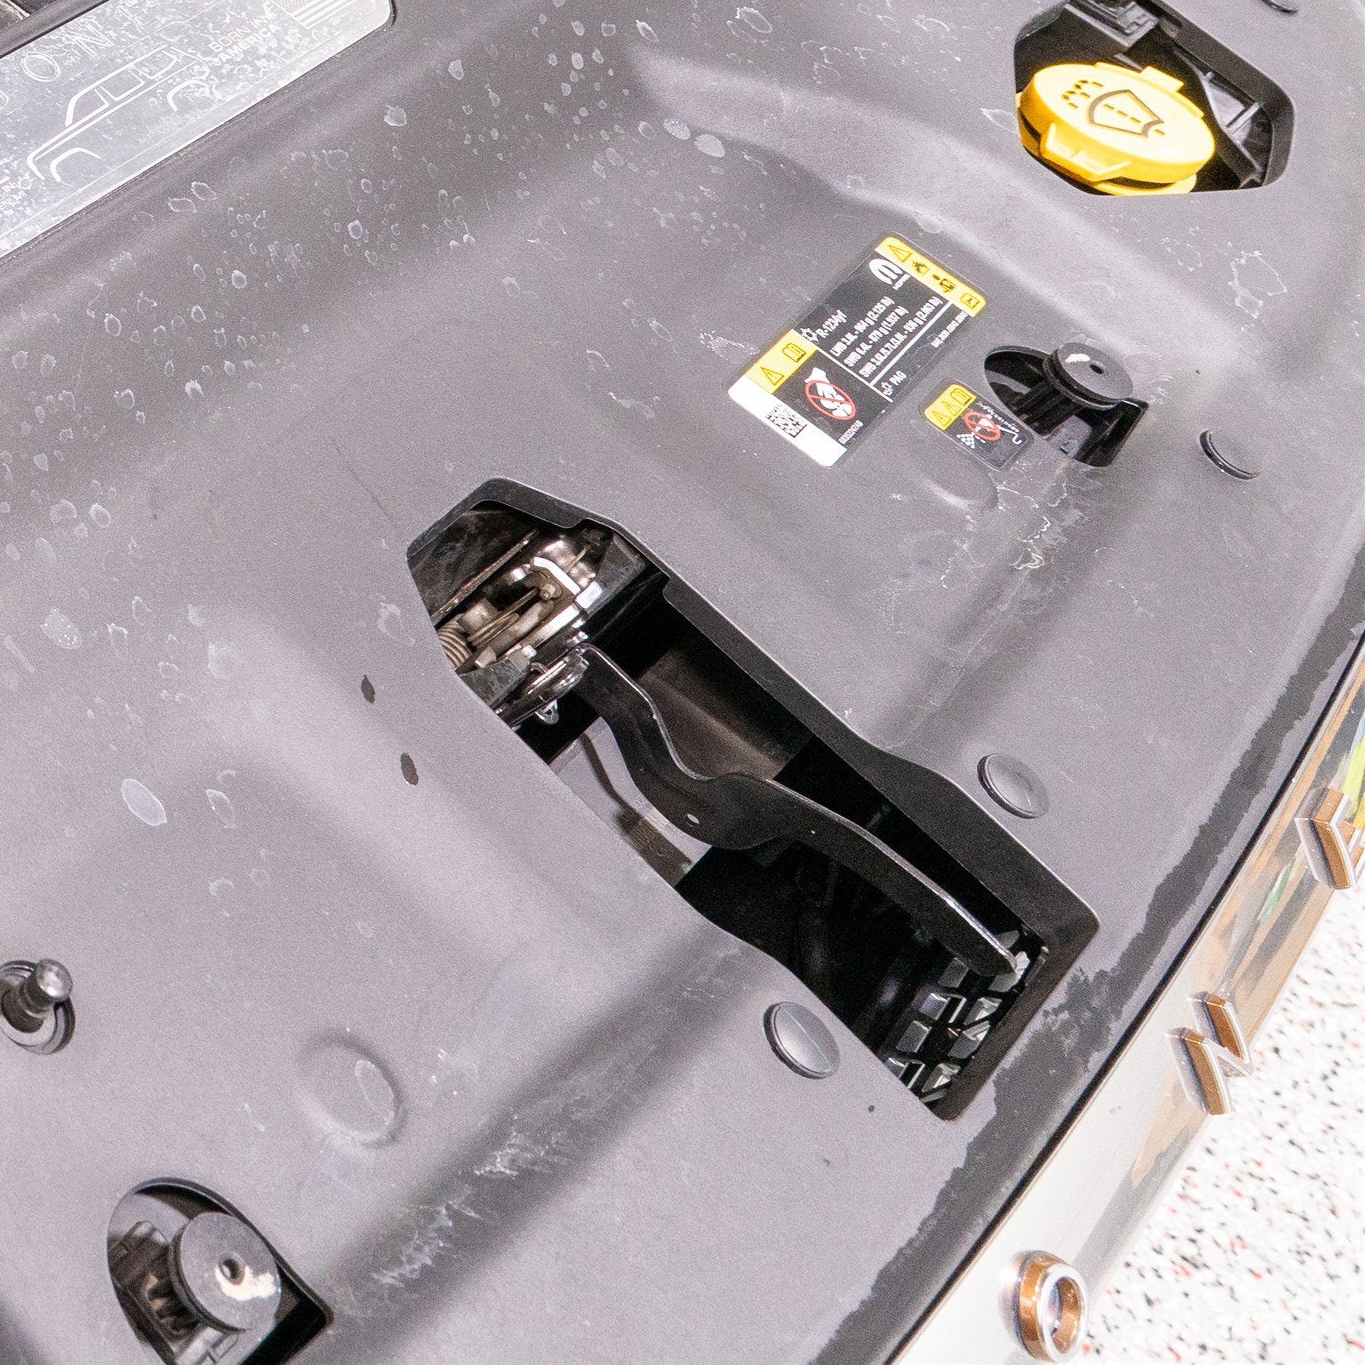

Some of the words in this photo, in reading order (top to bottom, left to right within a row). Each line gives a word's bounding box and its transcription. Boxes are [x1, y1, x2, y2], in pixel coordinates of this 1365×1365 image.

[207, 24, 251, 54] BORN
[217, 21, 281, 63] AMERICA
[889, 369, 907, 385] PAG
